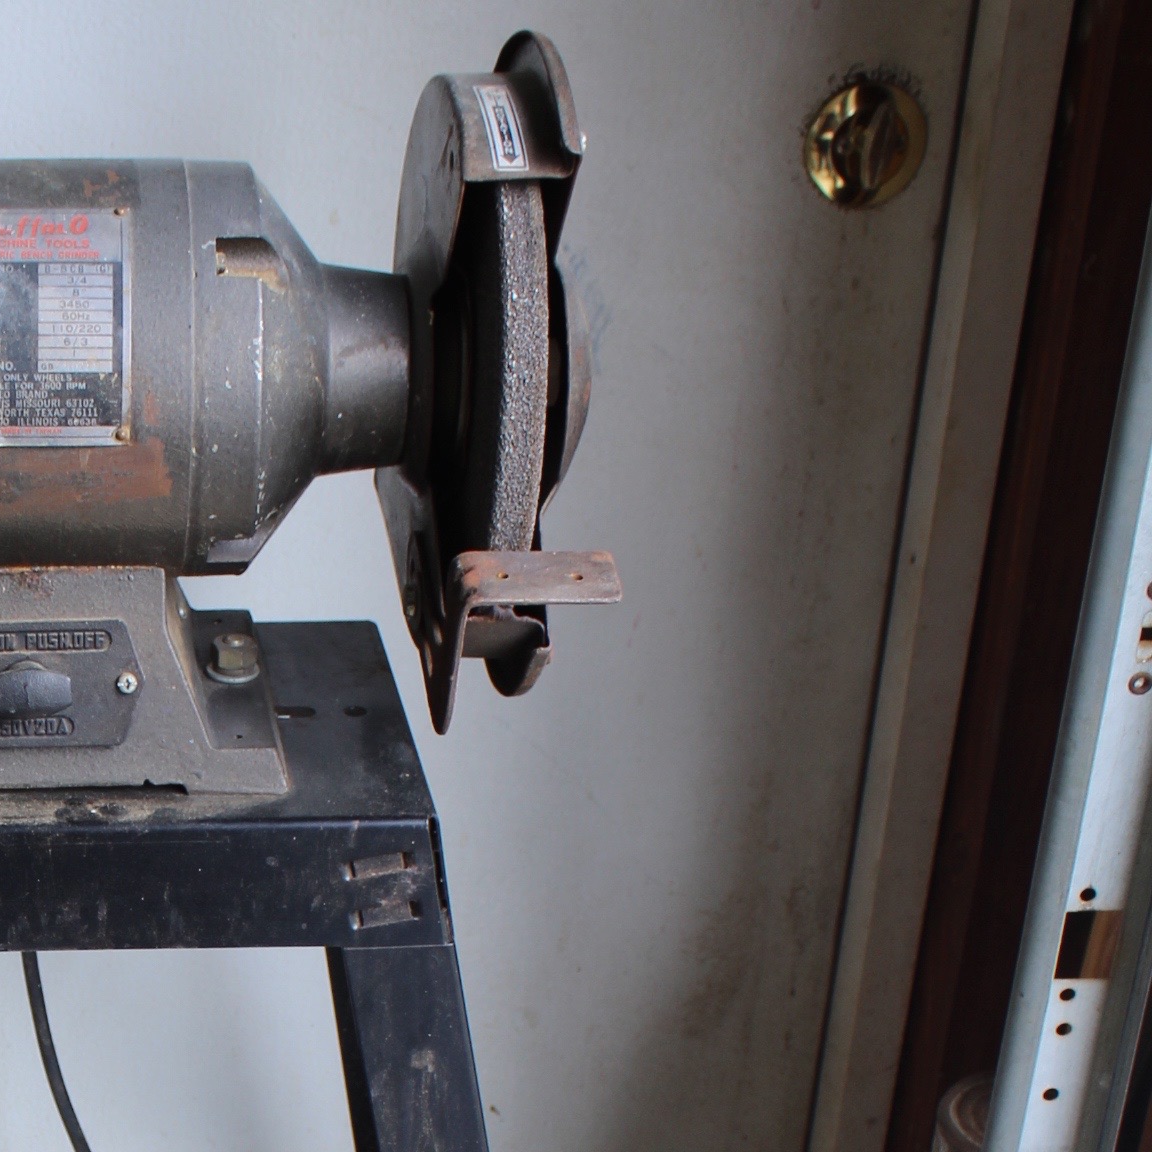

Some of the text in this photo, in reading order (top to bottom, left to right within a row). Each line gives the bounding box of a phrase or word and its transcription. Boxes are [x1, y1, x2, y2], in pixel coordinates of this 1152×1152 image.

[46, 239, 90, 249] TOOLS
[67, 276, 87, 285] 3/4
[60, 300, 90, 309] 3450
[62, 312, 90, 321] 60Hz
[52, 324, 102, 334] 110/220
[3, 373, 29, 382] ONLY
[34, 373, 73, 382] WHEELS
[15, 382, 34, 390] FOR
[66, 382, 86, 390] RPM
[15, 390, 48, 399] BRAND
[15, 399, 61, 408] MISSOURI
[66, 399, 95, 408] 63102
[36, 408, 66, 417] TEXAS
[71, 407, 98, 417] 76111
[17, 418, 59, 427] ILLINOIS
